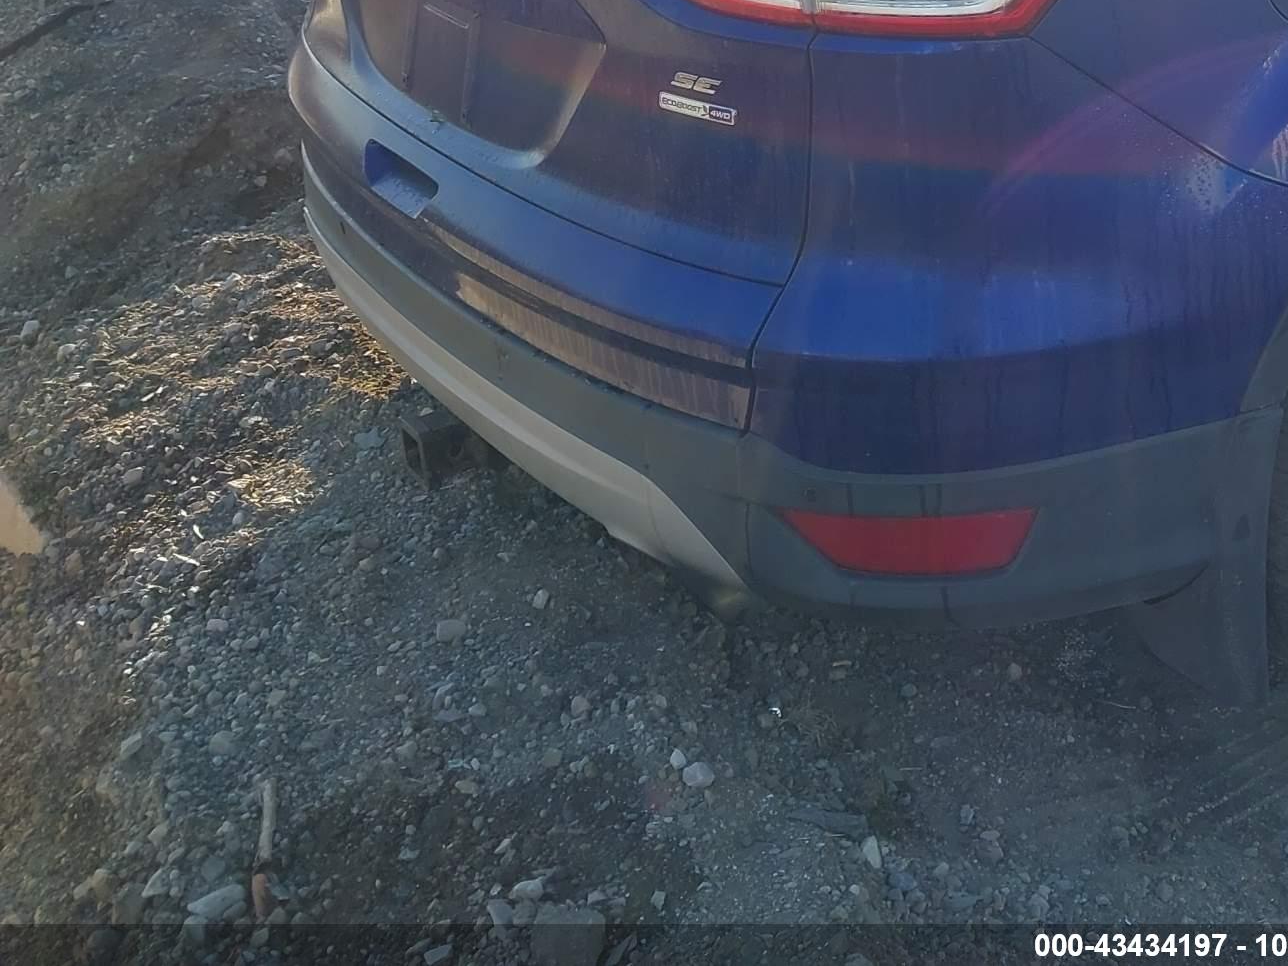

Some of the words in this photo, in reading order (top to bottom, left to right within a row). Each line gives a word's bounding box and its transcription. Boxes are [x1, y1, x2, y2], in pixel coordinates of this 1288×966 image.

[670, 71, 723, 94] SE
[662, 97, 702, 114] ECOBOOST
[710, 109, 731, 120] 4WD
